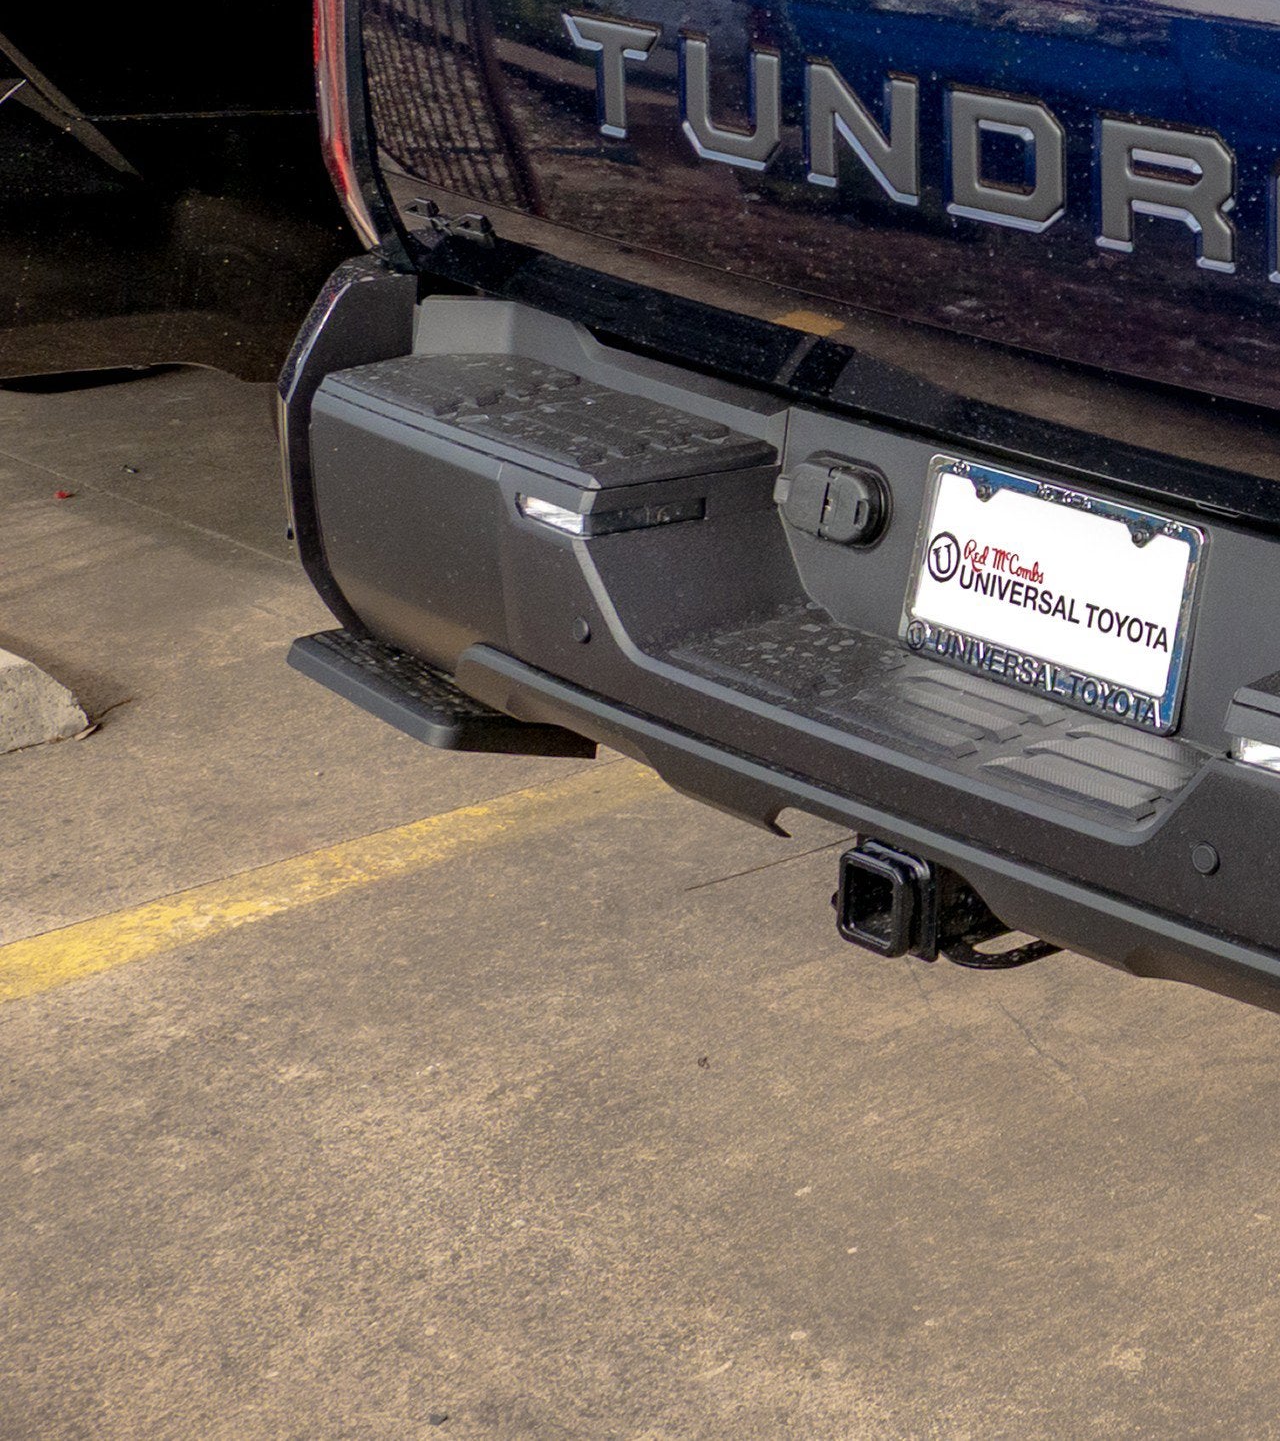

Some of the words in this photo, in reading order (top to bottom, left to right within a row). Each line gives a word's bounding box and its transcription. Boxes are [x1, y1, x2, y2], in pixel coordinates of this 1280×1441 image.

[964, 539, 989, 572] Red
[992, 546, 1044, 585] McCombs
[959, 563, 1080, 625] UNIVERSAL
[1086, 603, 1169, 653] TOYOTA
[934, 627, 1065, 696] UNIVERSAL
[1069, 673, 1162, 728] TOYOTA
